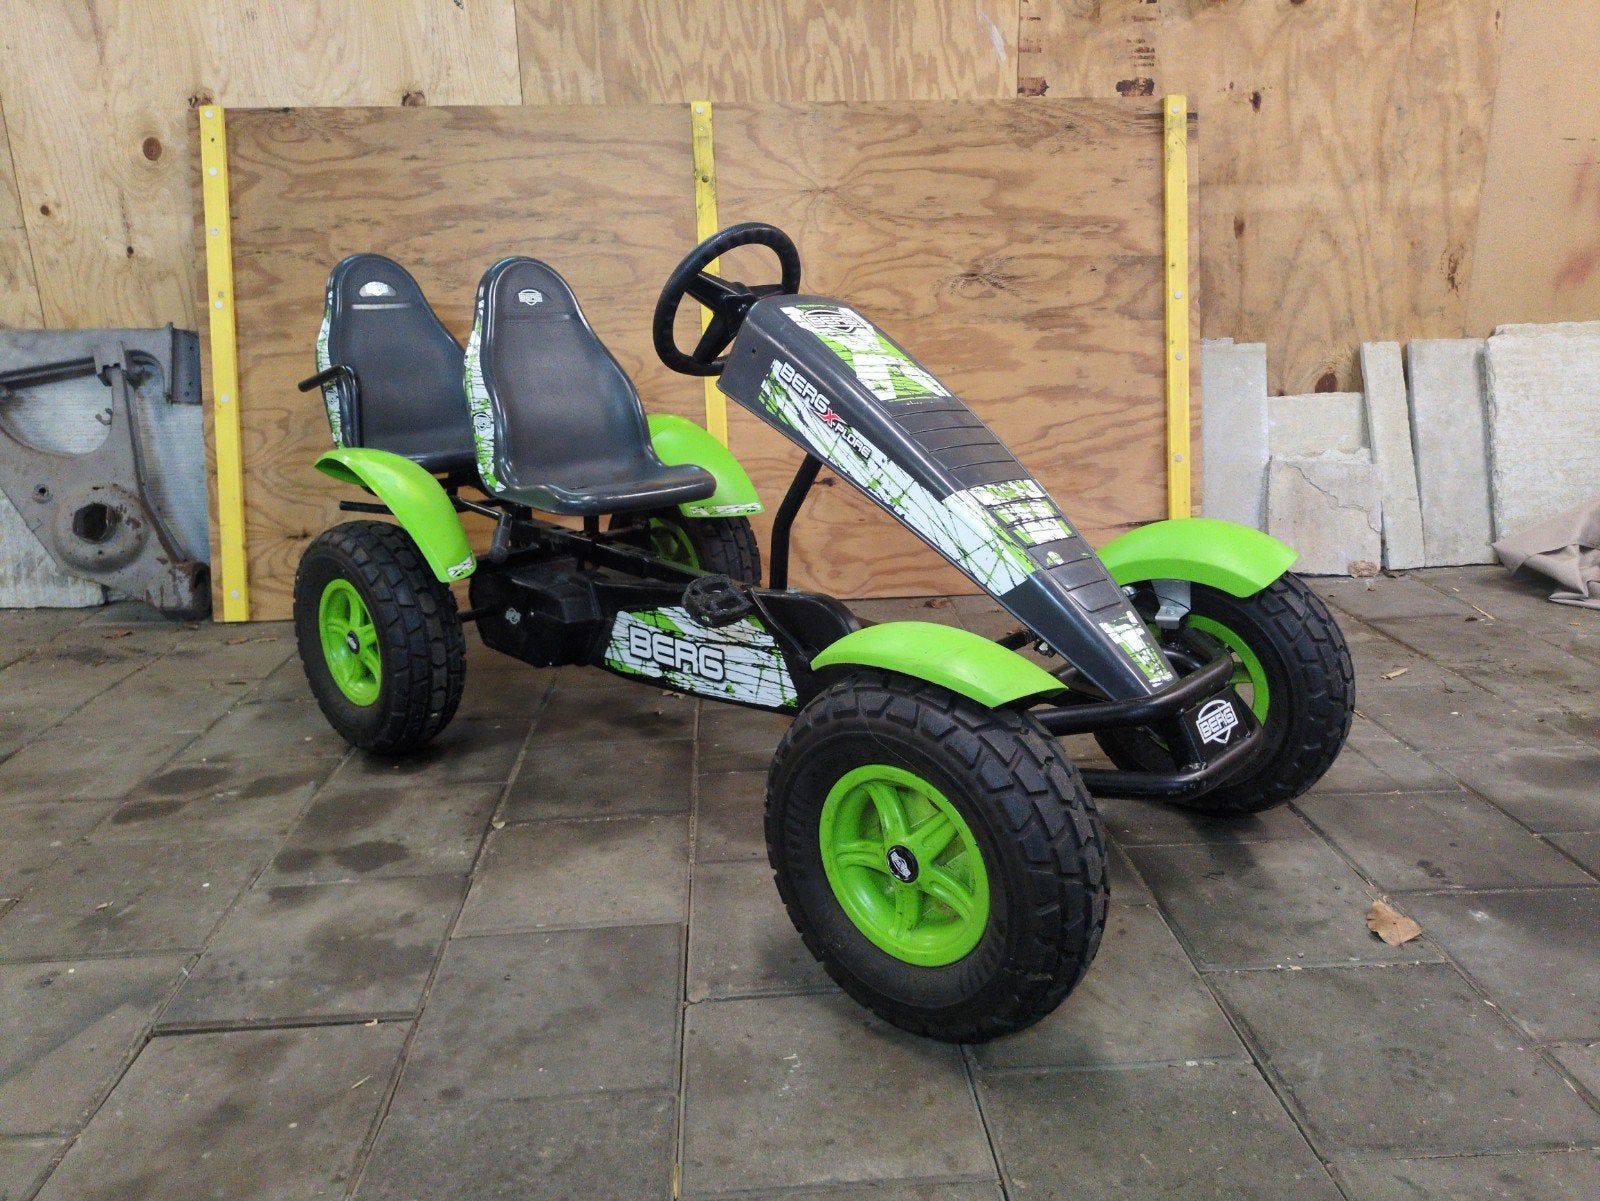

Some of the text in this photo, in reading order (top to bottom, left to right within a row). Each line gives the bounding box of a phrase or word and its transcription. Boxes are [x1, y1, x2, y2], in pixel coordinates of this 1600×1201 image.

[780, 362, 830, 413] BERG
[629, 625, 725, 683] BERG
[1199, 707, 1235, 739] BERG
